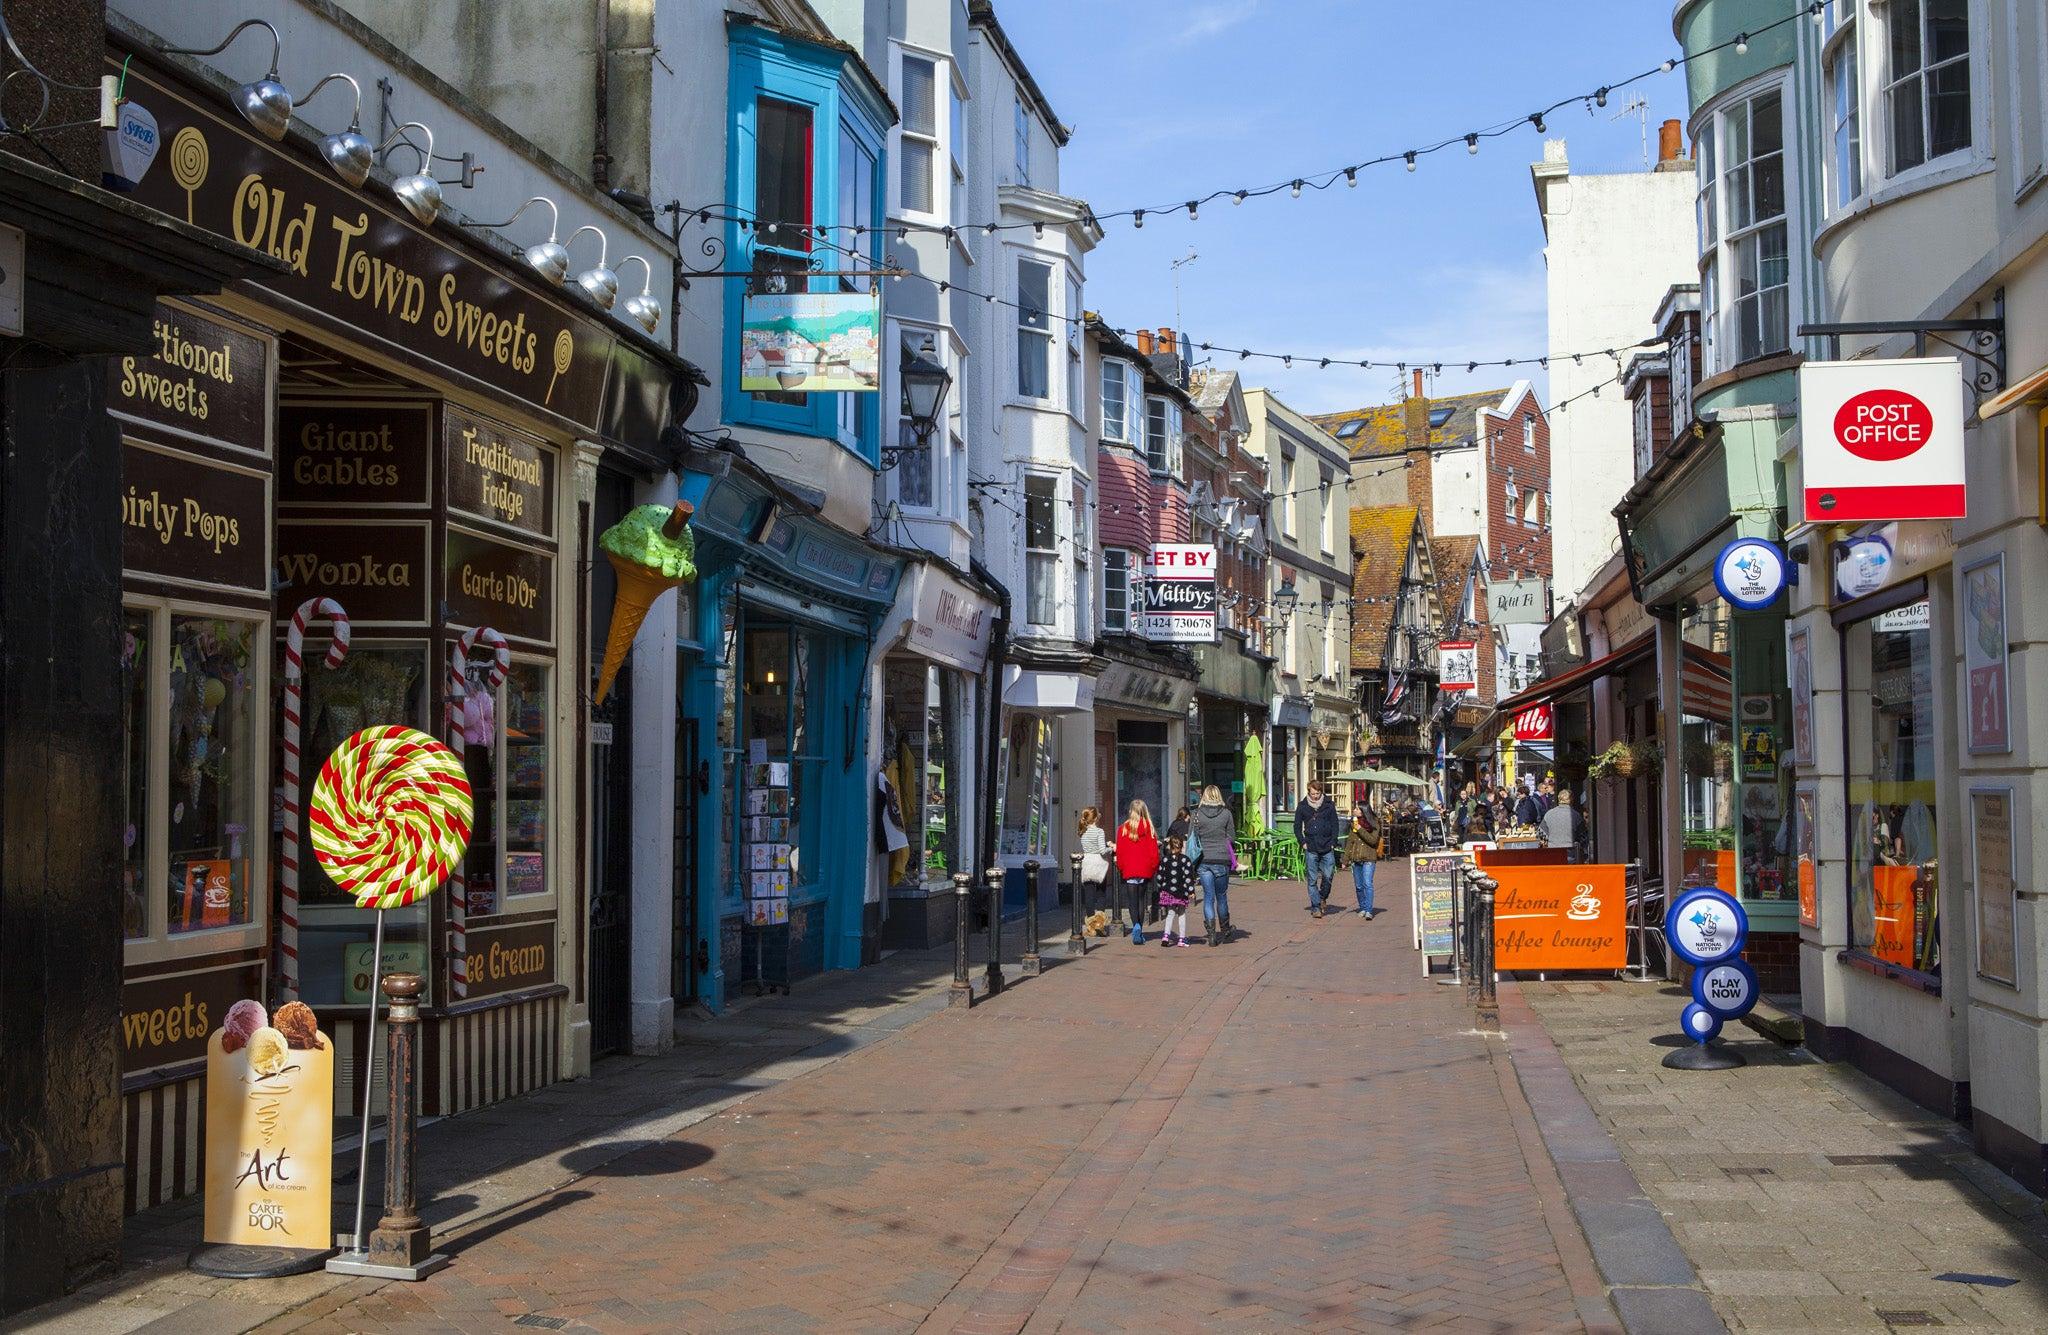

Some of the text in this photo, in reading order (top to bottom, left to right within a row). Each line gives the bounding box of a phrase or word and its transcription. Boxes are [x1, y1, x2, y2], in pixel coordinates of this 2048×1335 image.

[232, 173, 537, 375] Old Town Sweets
[122, 356, 208, 420] Sweets
[1856, 404, 1913, 422] POST
[301, 422, 394, 451] Giant
[1843, 424, 1921, 443] OFFICE
[463, 427, 541, 487] Traditional
[294, 455, 399, 486] Cables
[183, 498, 240, 554] Pops
[279, 553, 411, 586] Wonka
[1144, 551, 1211, 566] LET BY
[462, 563, 503, 602] Carte
[1147, 617, 1212, 628] 1424 730678
[1516, 707, 1550, 737] illy
[1495, 888, 1560, 910] Aroma
[1495, 930, 1613, 953] offee lounge
[359, 948, 394, 967] Cme
[465, 941, 545, 983] ce Cream
[1711, 979, 1741, 988] PLAY
[1711, 988, 1742, 999] NOW
[122, 991, 209, 1051] weets
[234, 1147, 291, 1192] Art
[286, 1184, 307, 1192] cream
[248, 1202, 284, 1215] CARTE
[248, 1213, 292, 1236] D'OR
